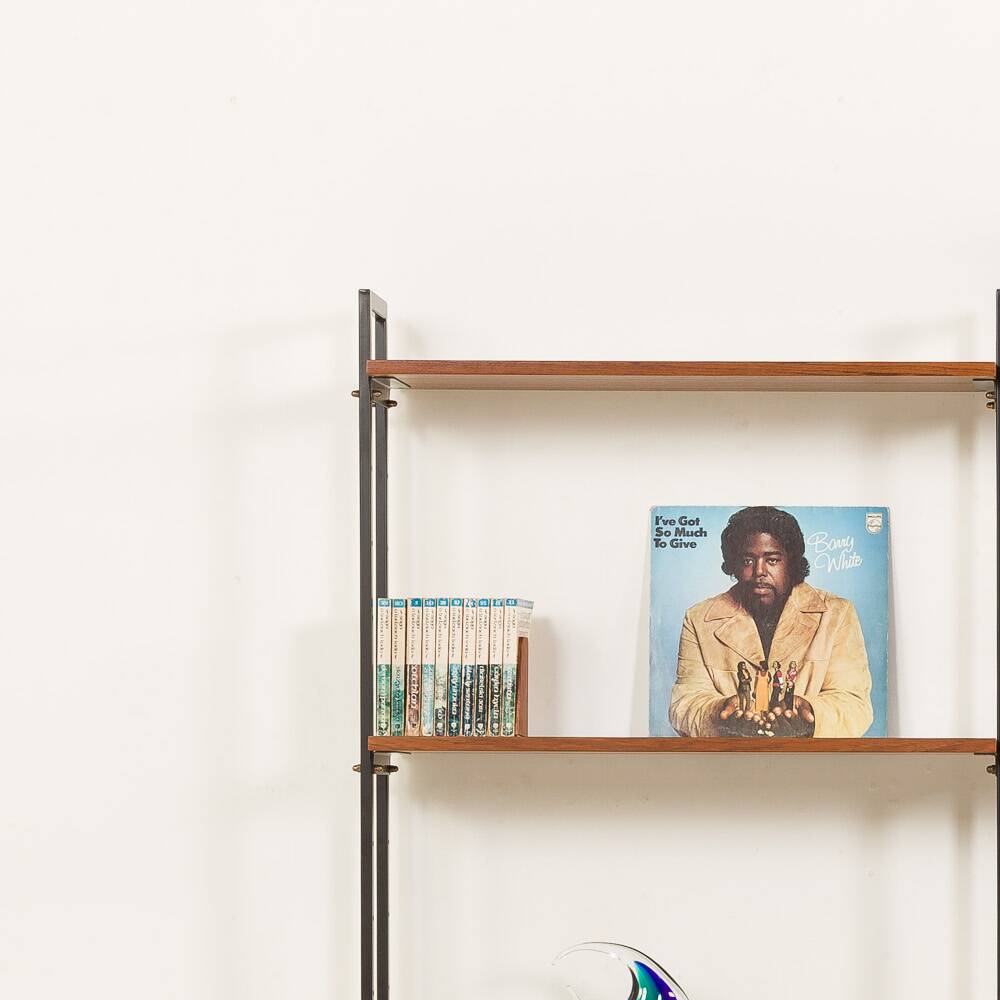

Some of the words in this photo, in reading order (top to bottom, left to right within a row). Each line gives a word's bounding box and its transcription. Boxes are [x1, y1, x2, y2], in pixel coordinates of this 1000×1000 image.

[655, 515, 676, 526] I've
[678, 515, 700, 526] Got
[655, 526, 671, 537] So
[674, 526, 707, 537] Much
[653, 538, 667, 548] To
[669, 538, 697, 548] Give
[807, 532, 855, 553] Barry
[814, 549, 863, 573] White
